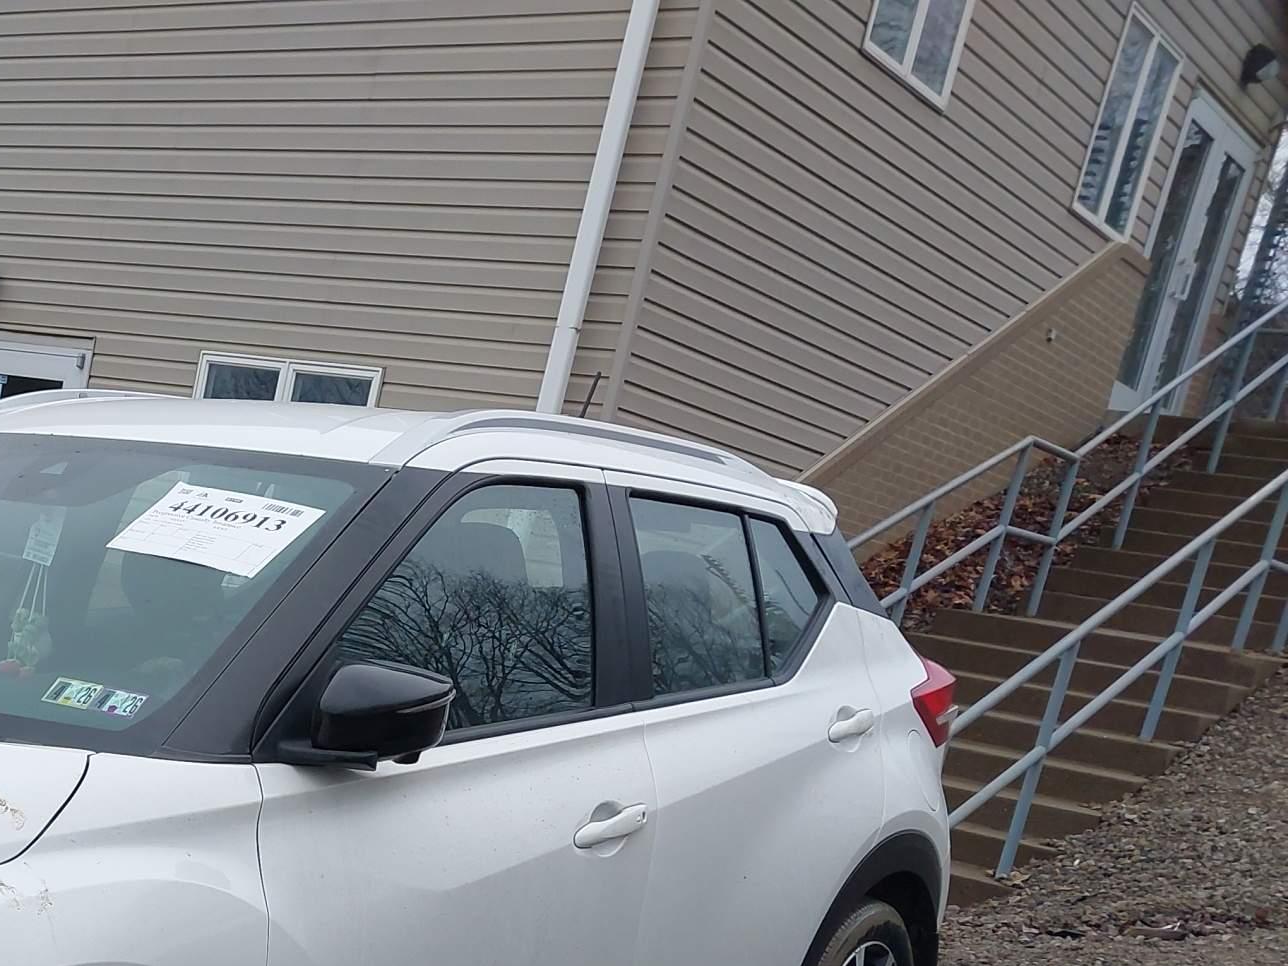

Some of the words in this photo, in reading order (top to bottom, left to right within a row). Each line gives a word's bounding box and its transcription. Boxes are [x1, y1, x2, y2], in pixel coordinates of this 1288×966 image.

[168, 500, 287, 532] 44106913
[76, 687, 97, 705] 26
[122, 697, 144, 714] 26
